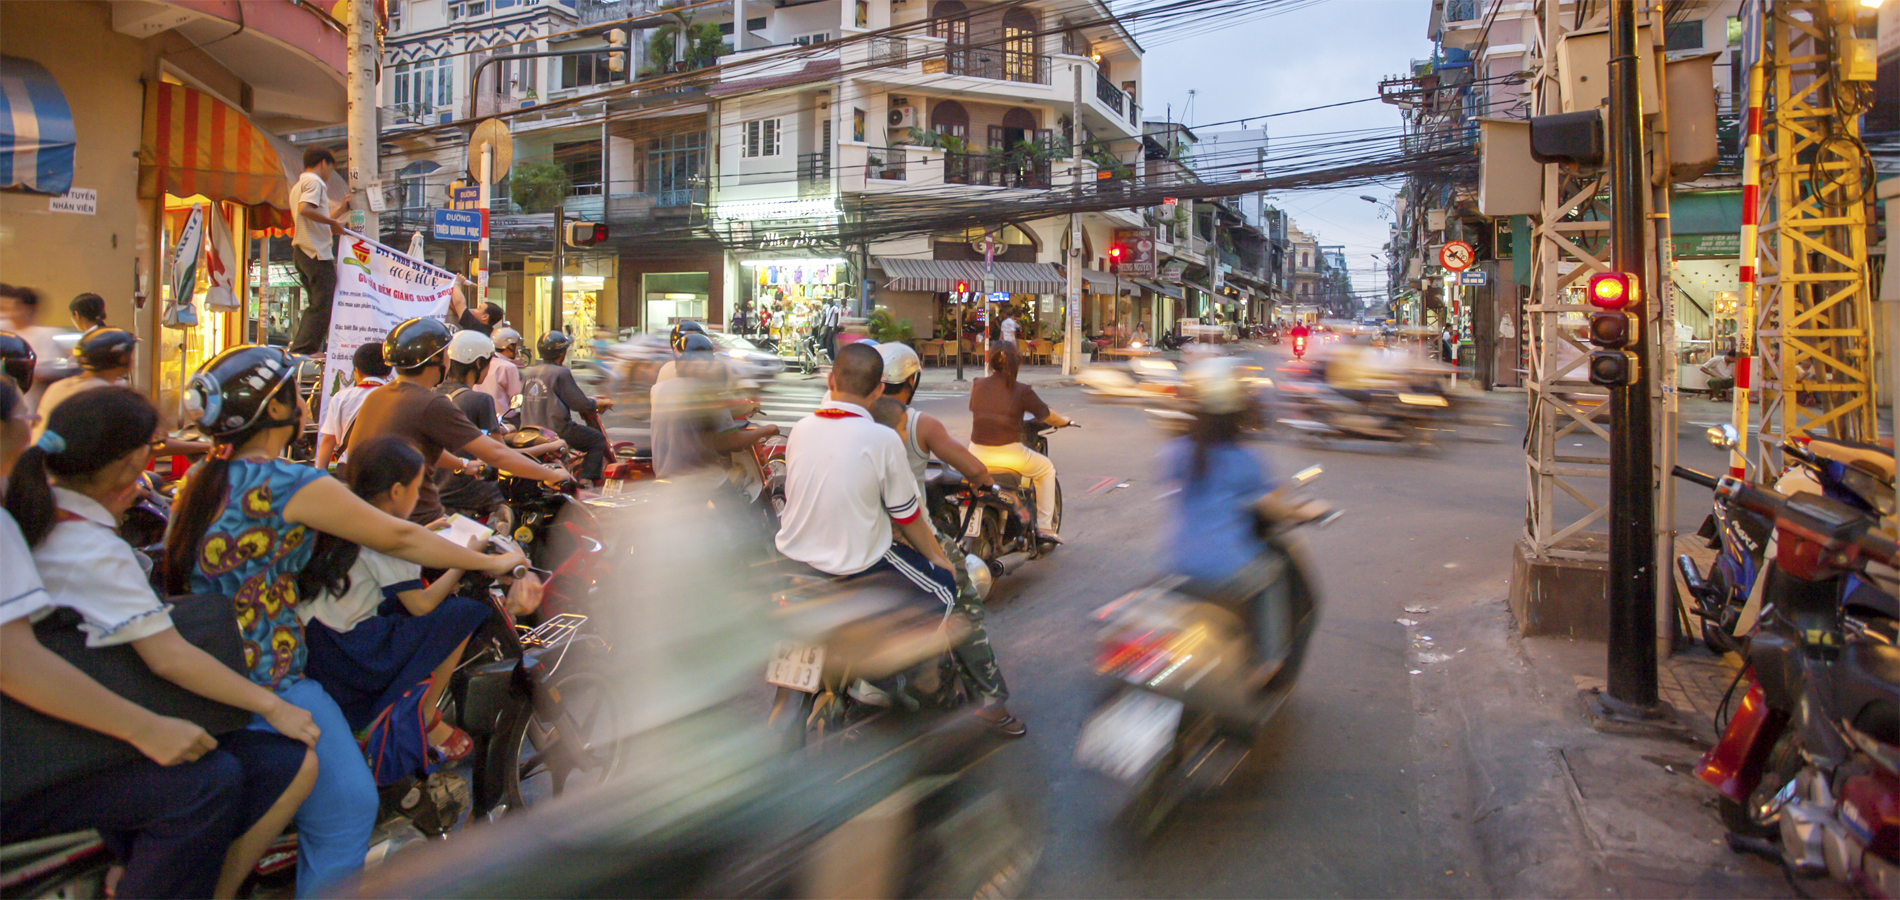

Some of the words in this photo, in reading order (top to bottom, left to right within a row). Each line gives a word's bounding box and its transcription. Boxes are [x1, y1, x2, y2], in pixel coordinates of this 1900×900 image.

[979, 243, 1003, 255] 37
[389, 265, 413, 284] HUỆ
[414, 273, 439, 290] HUỆ
